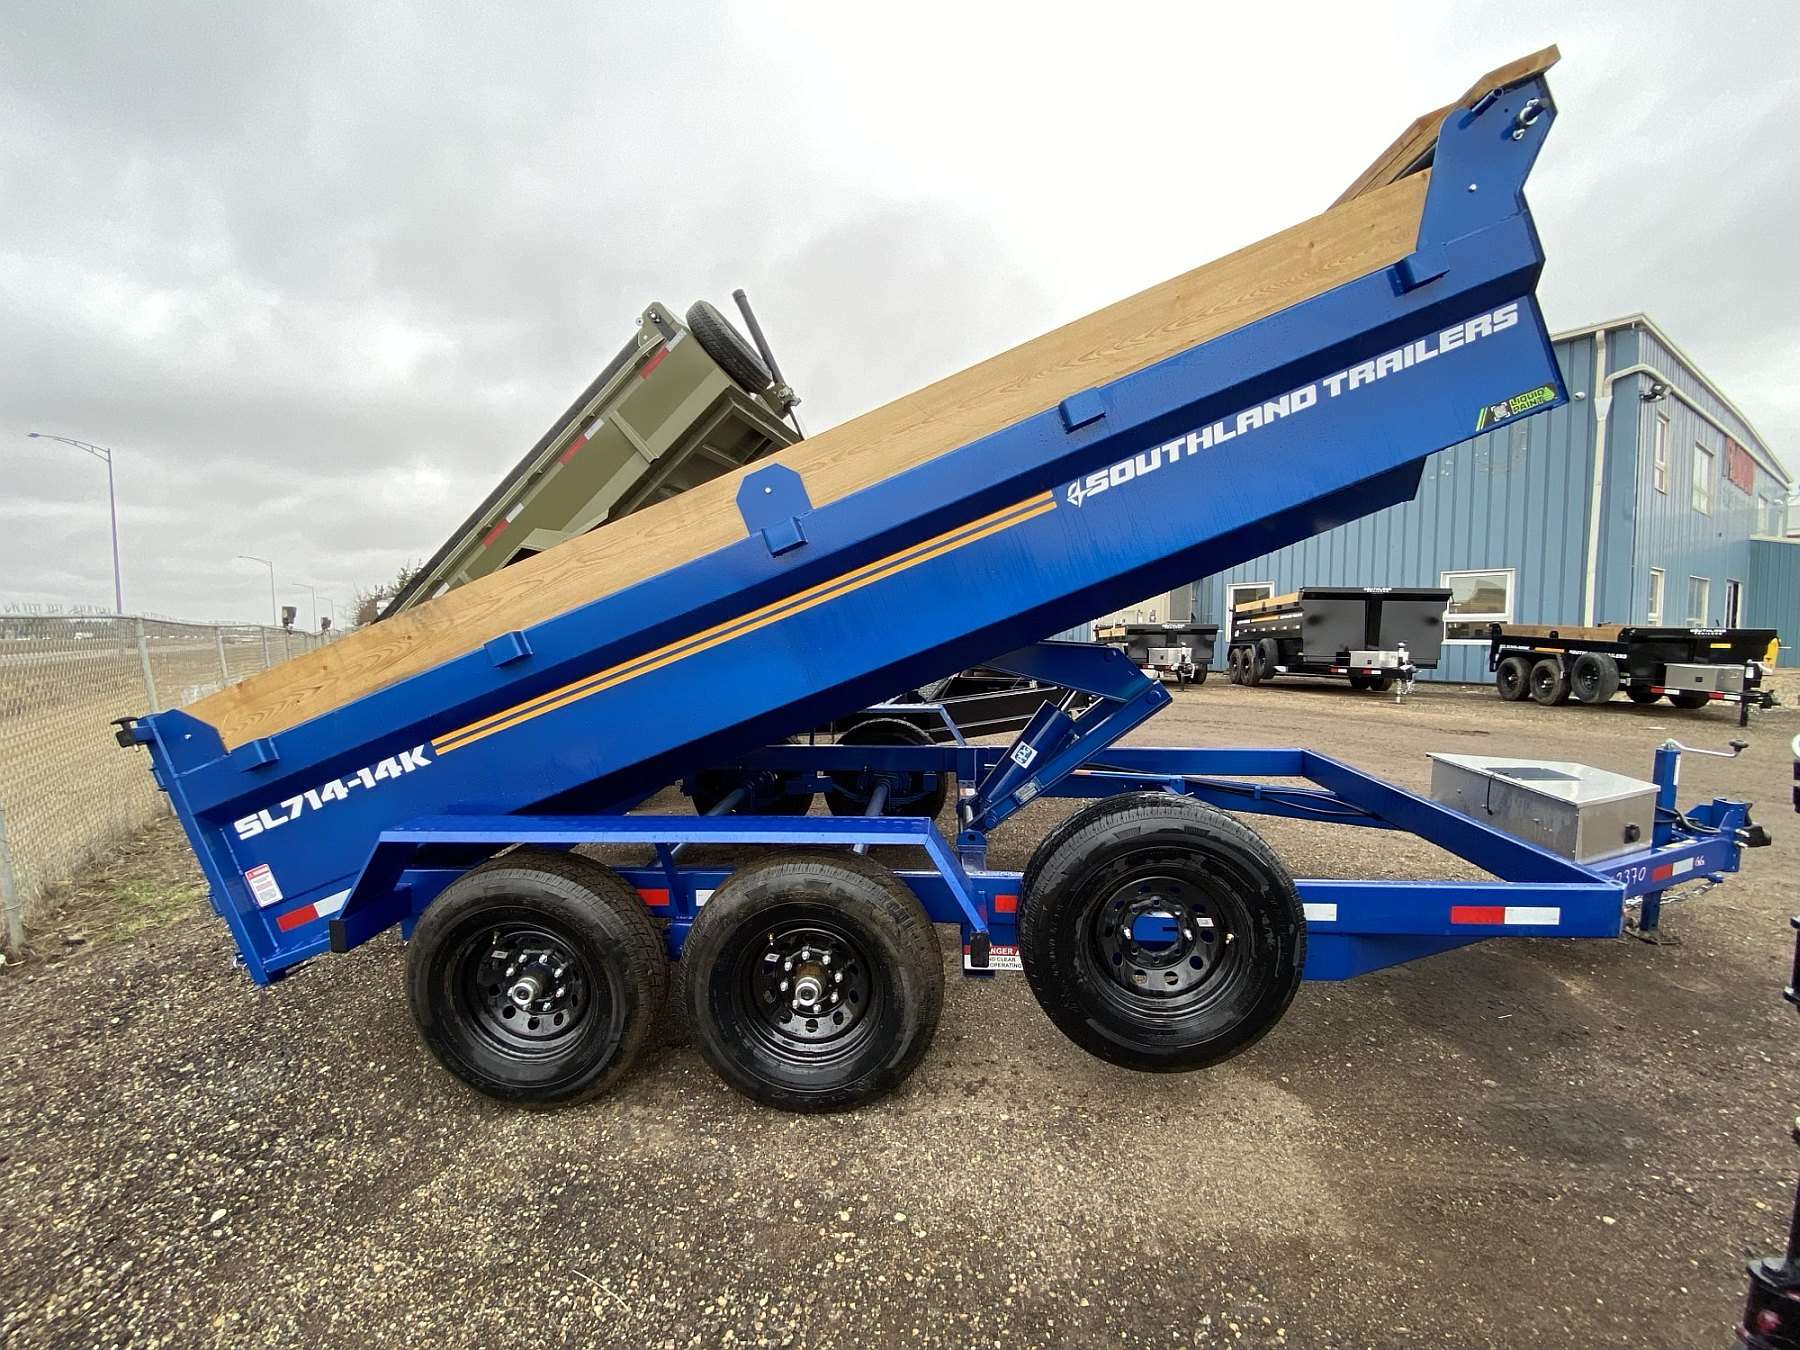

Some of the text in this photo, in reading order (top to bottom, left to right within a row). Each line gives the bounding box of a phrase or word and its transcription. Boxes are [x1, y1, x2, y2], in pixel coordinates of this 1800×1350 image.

[1086, 303, 1518, 497] SOUTHLAND TRAILERS
[1510, 389, 1545, 407] LIQUID
[234, 744, 432, 840] SL714-14K
[989, 947, 1014, 955] NGER
